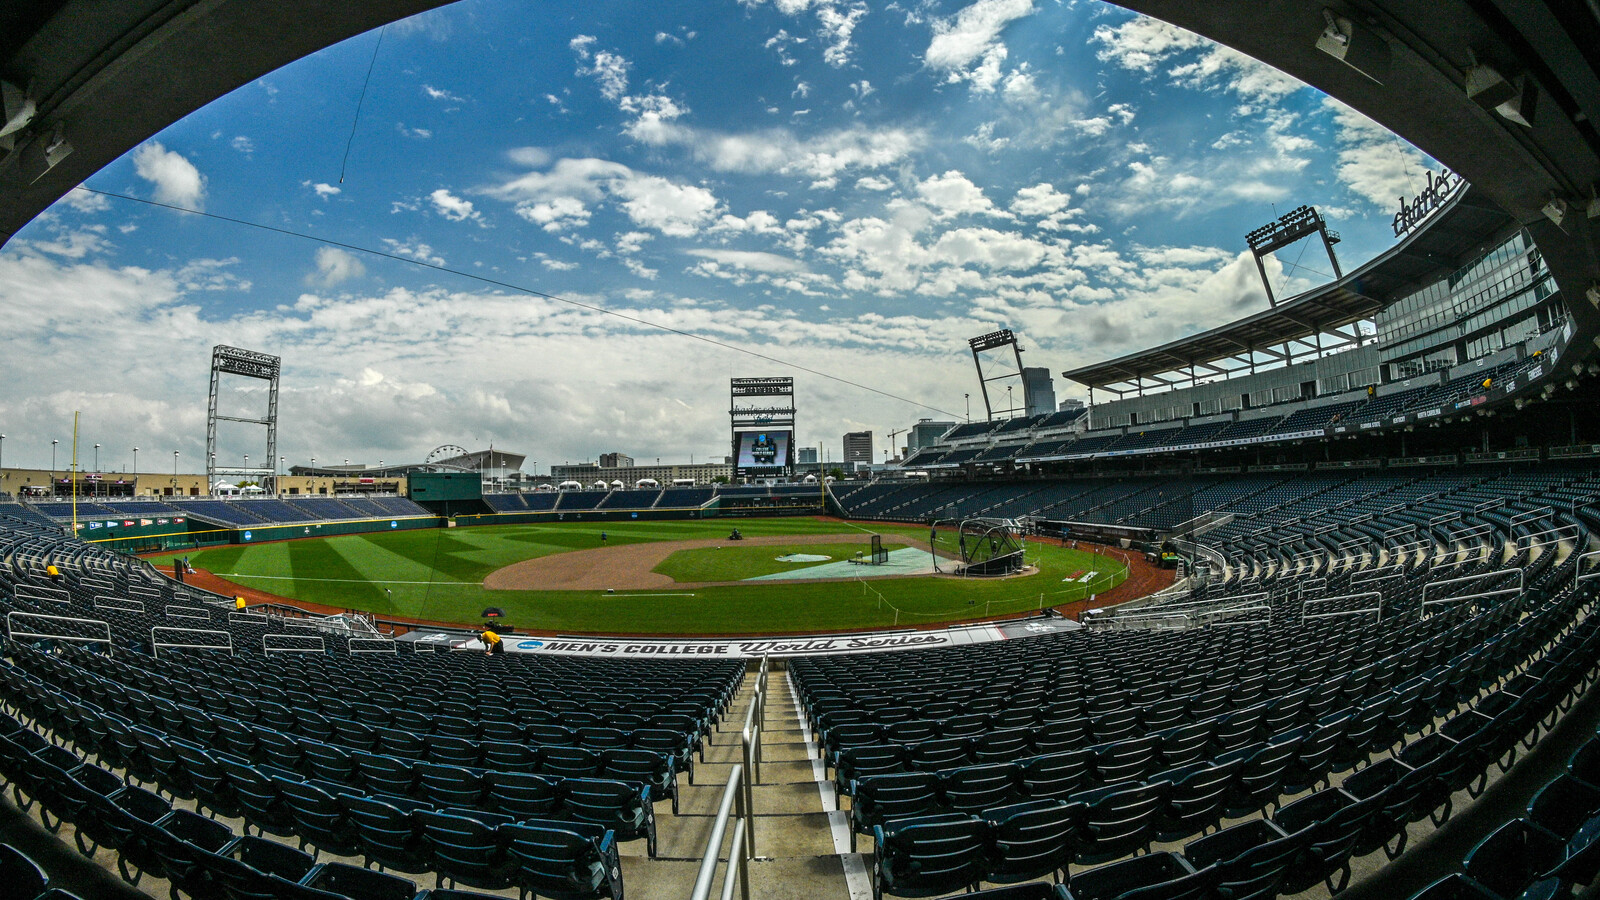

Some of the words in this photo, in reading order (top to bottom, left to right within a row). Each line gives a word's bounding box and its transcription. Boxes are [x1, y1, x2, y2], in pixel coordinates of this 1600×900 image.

[1391, 169, 1453, 238] charles
[545, 642, 619, 653] MEN'S
[623, 645, 729, 654] COLLEGE
[739, 639, 839, 652] World
[846, 634, 948, 648] Series
